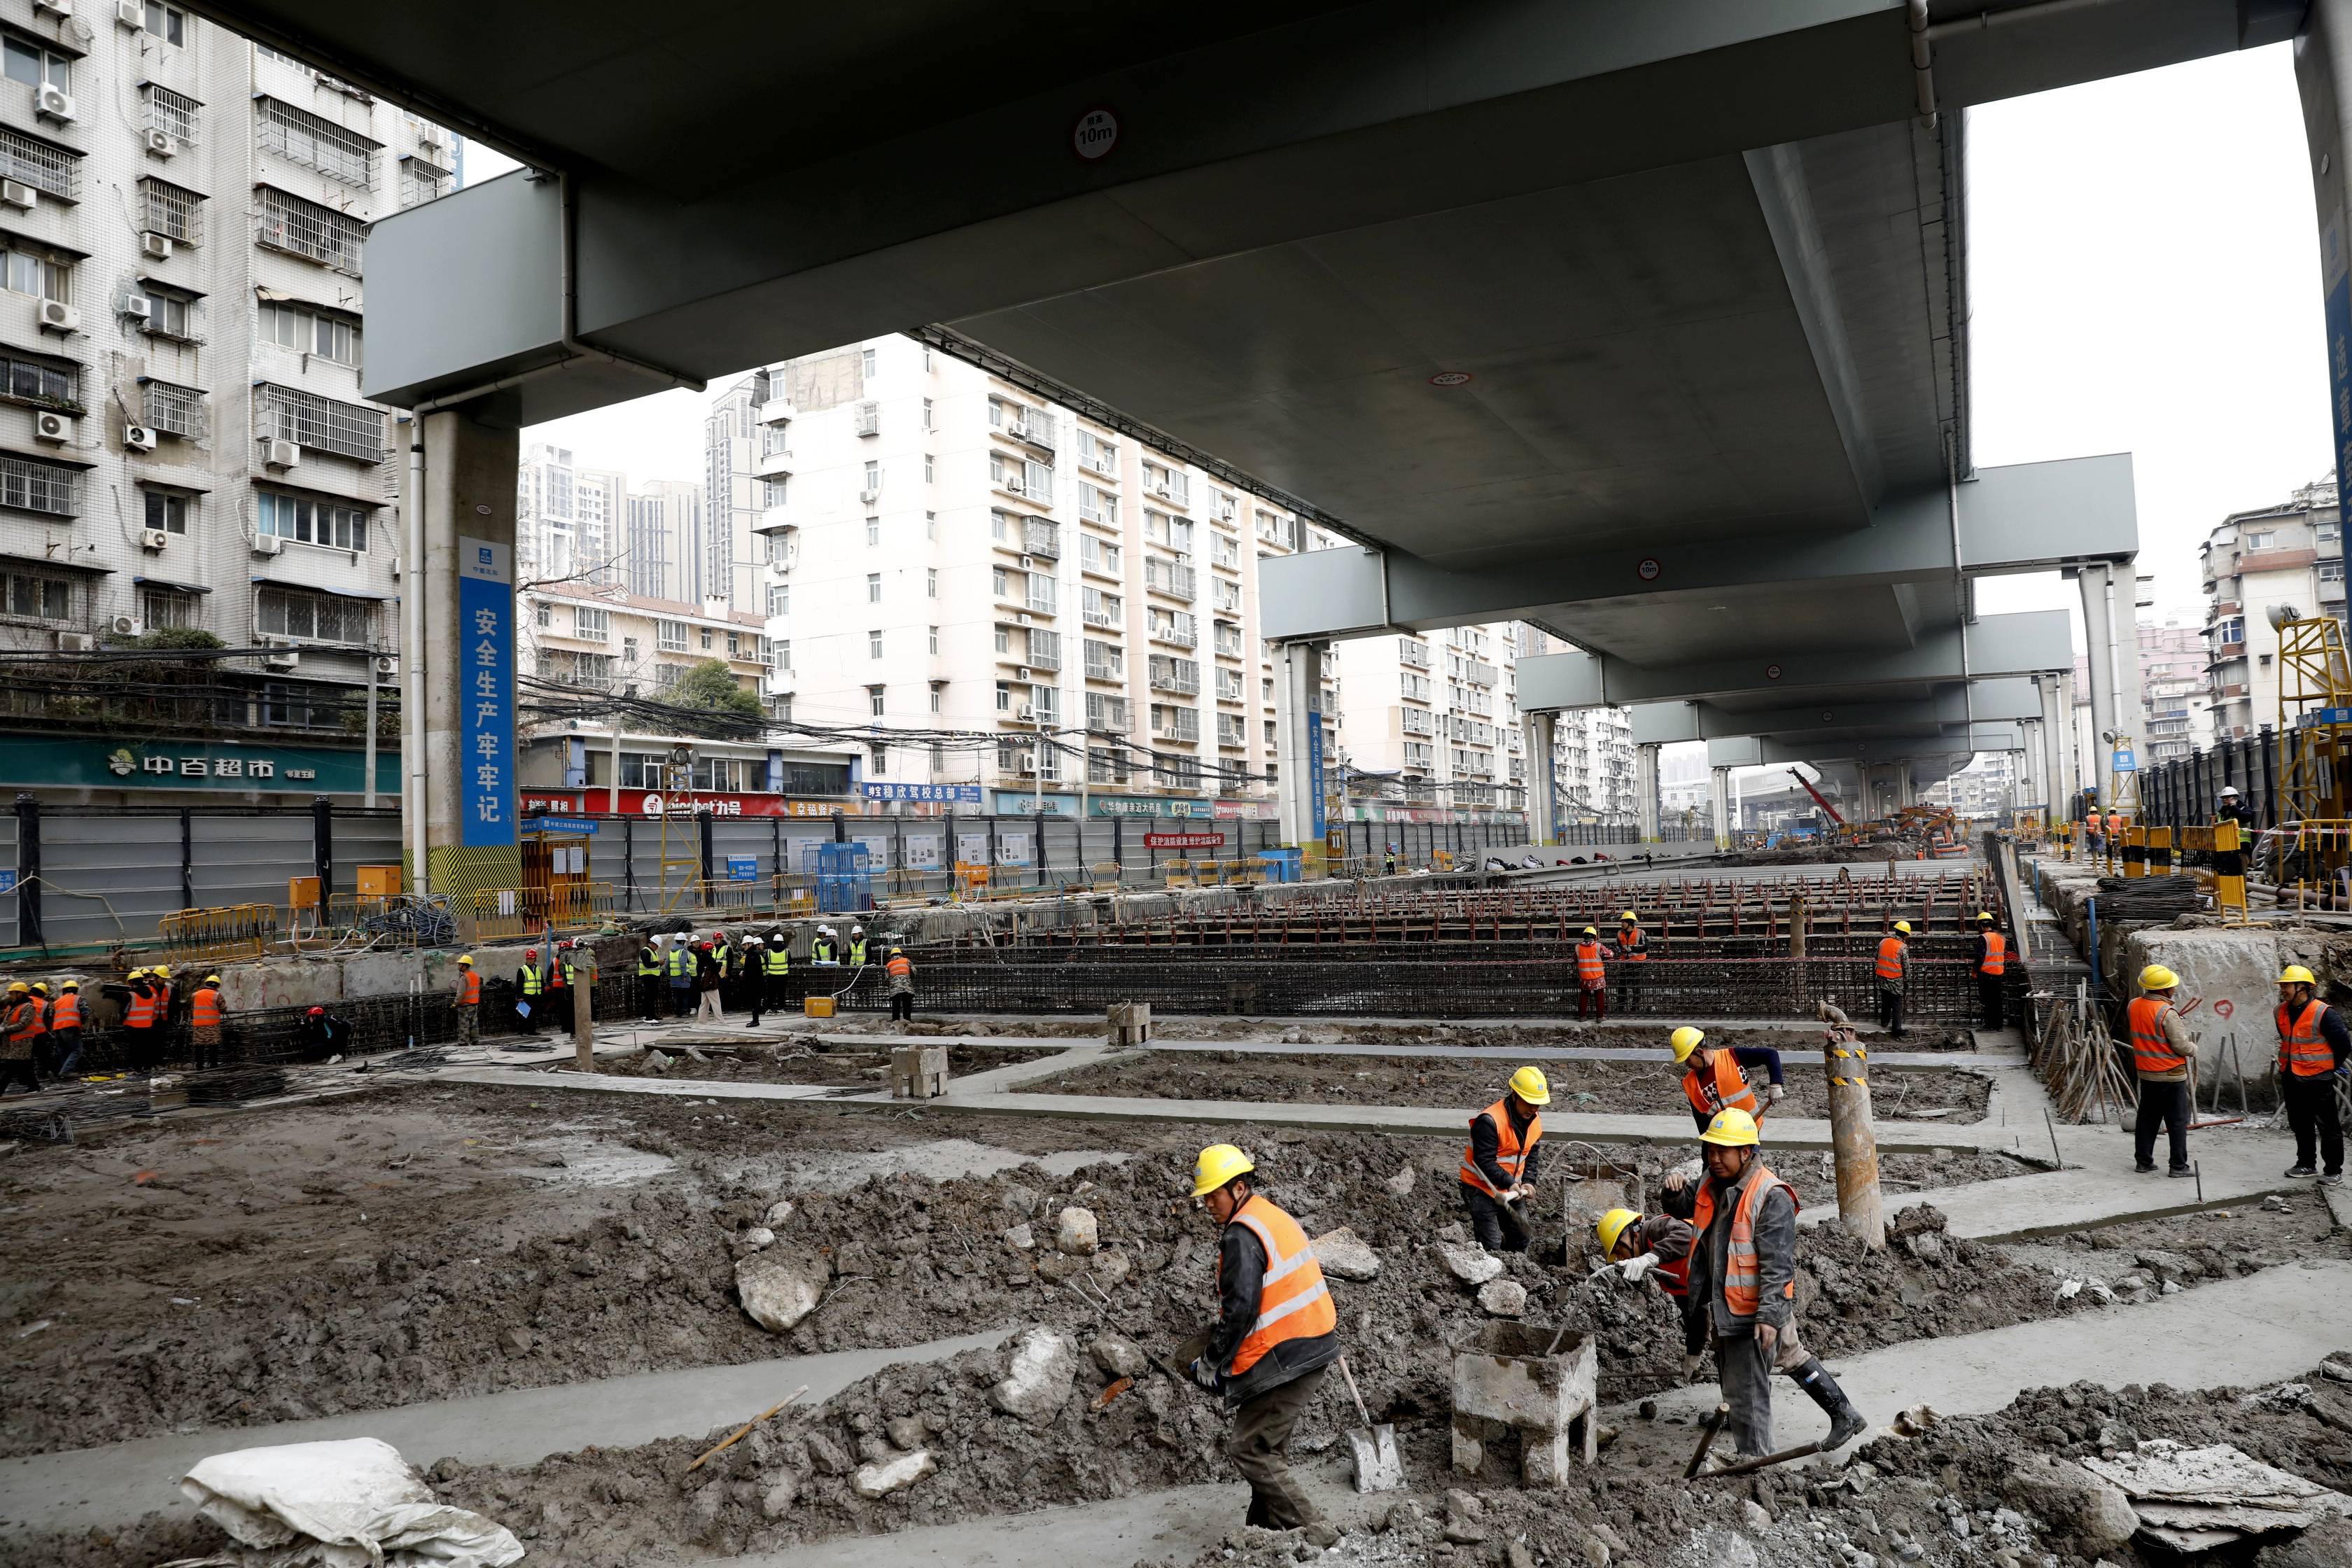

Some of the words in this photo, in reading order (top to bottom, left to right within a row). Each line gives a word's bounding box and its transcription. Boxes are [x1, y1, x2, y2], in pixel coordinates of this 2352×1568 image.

[1079, 127, 1112, 145] 10m
[475, 608, 500, 822] 安全生产牢牢记
[144, 755, 274, 777] 中百超市
[1312, 724, 1322, 823] 安全与质量同行
[1150, 836, 1188, 846] 保护消防设施
[1189, 836, 1222, 846] 维护消防安全
